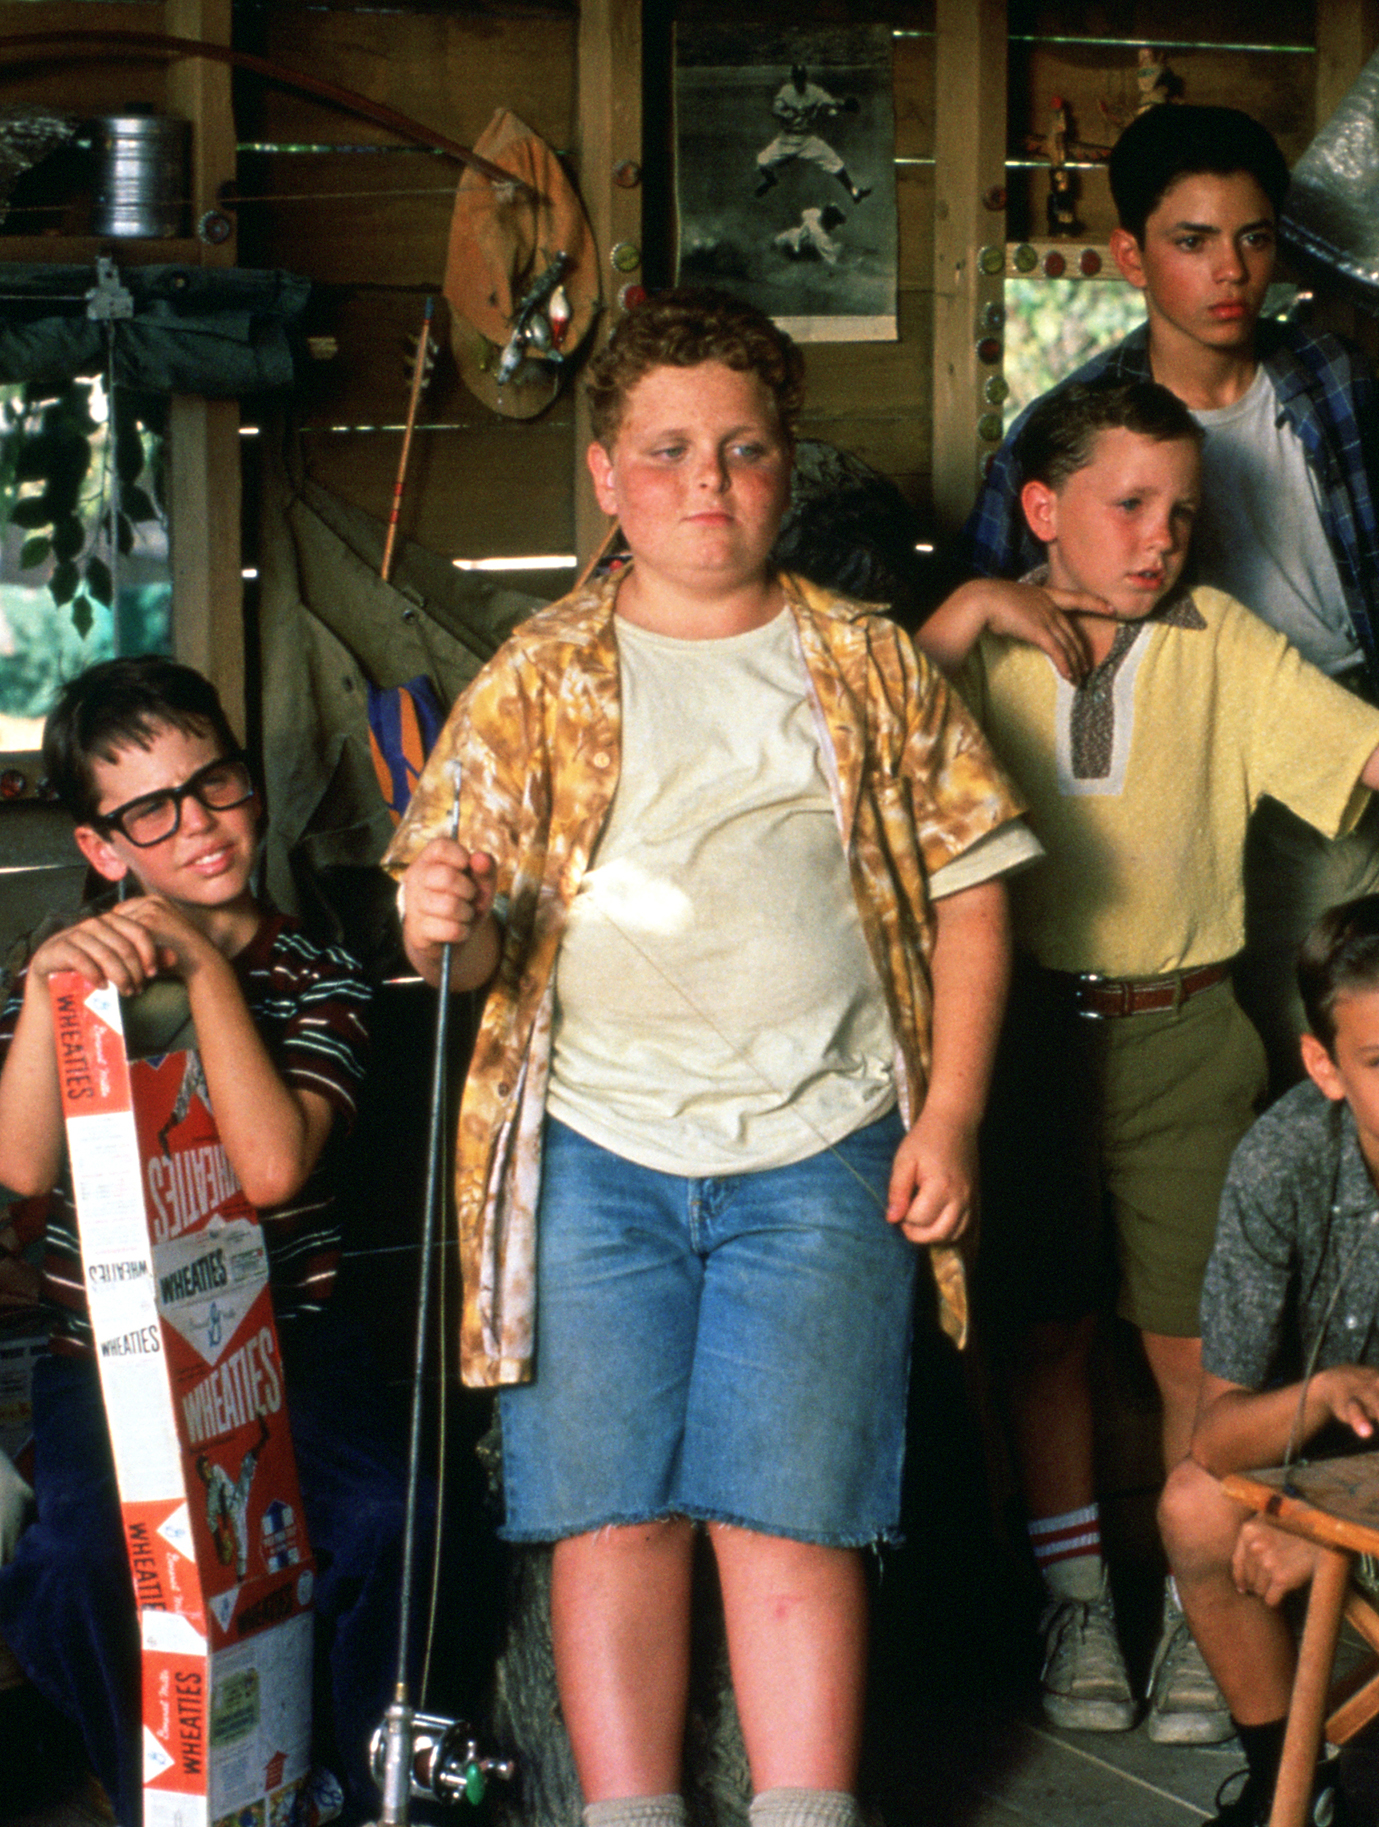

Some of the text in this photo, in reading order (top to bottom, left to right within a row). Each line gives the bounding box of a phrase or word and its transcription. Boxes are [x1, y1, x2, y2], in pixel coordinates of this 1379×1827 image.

[57, 995, 94, 1100] WHEATIES
[88, 1260, 148, 1284] WHEATIES
[159, 1248, 228, 1304] WHEATIES
[101, 1325, 161, 1357] WHEATIES
[183, 1327, 282, 1443] WHEATIES
[128, 1522, 167, 1611] WHEATIE
[174, 1671, 202, 1774] WHEATIES
